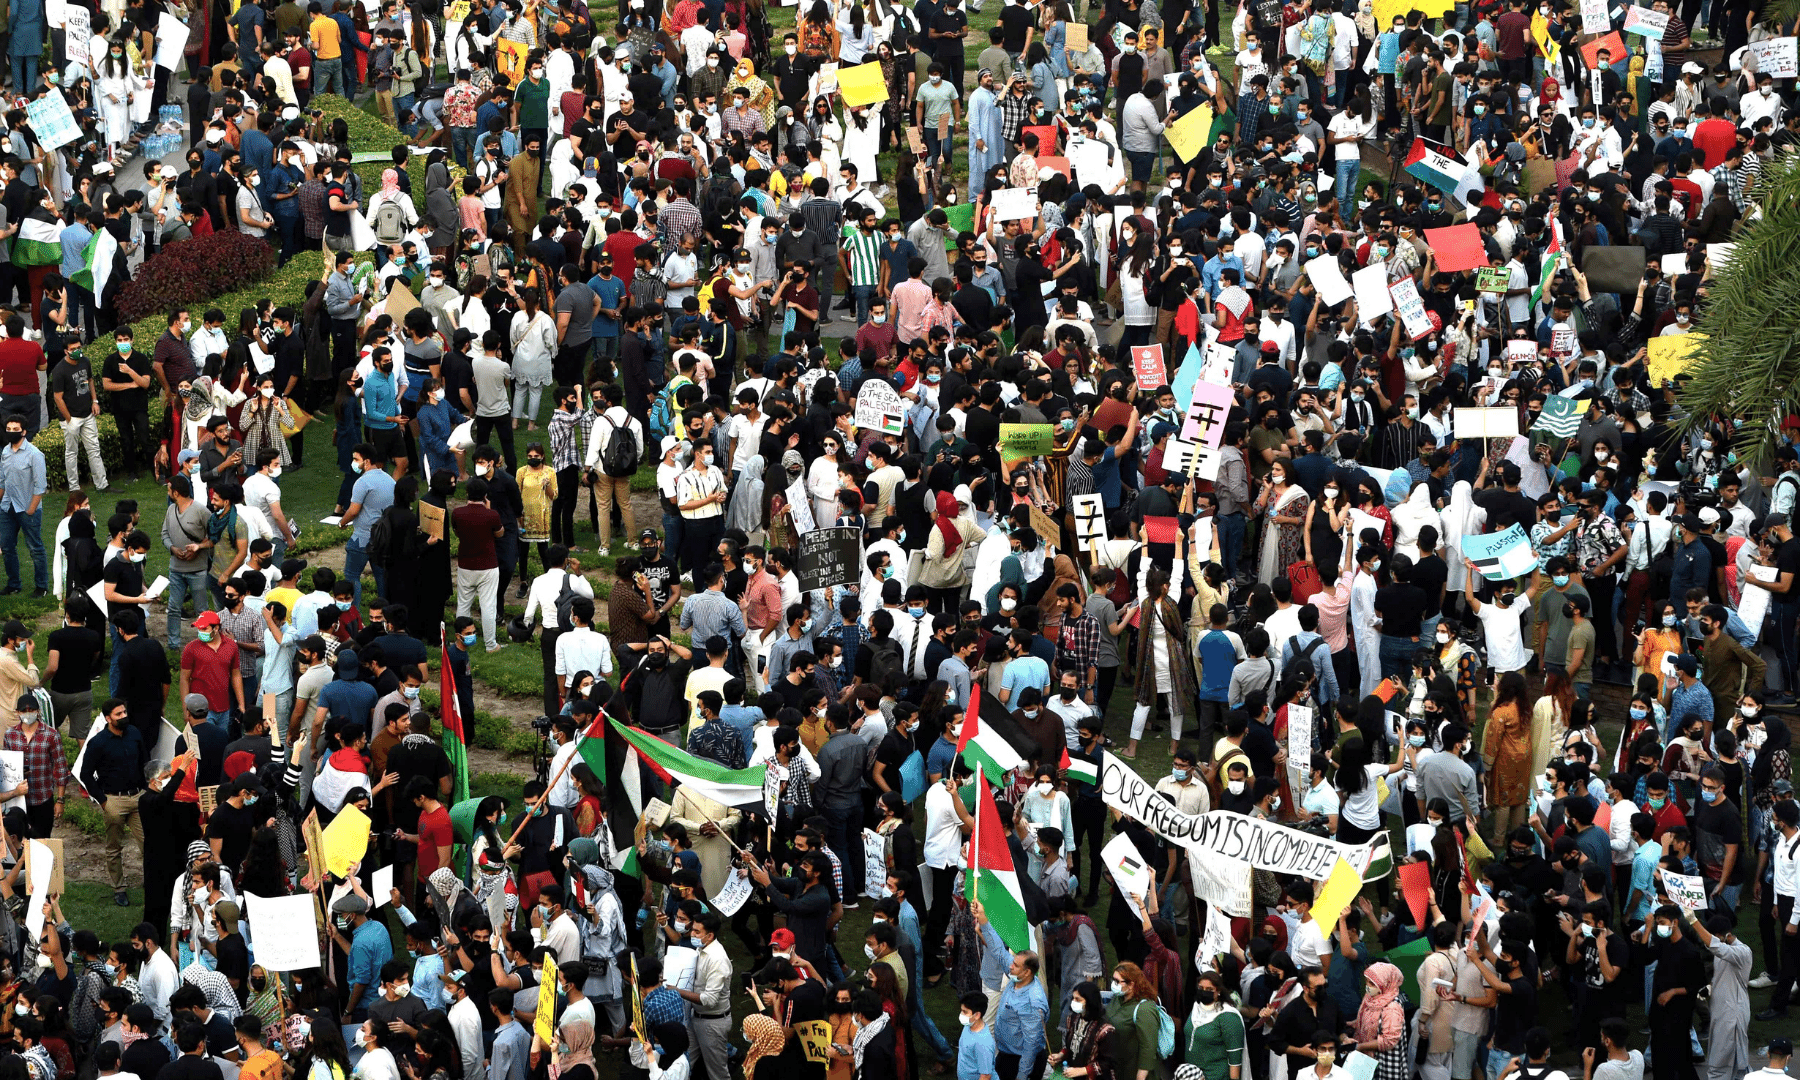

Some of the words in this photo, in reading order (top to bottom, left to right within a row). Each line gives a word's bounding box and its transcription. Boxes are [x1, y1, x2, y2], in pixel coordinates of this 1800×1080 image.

[1436, 145, 1457, 159] END
[1434, 154, 1450, 170] THE
[868, 389, 883, 400] THE
[884, 393, 900, 404] SEA
[859, 399, 902, 414] PALESTINE
[804, 529, 836, 545] PEACE
[842, 528, 856, 540] IN
[799, 541, 829, 559] PALESTINE
[817, 549, 840, 566] NOT
[836, 563, 844, 572] IN
[1102, 763, 1144, 815] OUR
[1142, 793, 1221, 849] FREEDOM
[1216, 815, 1248, 857] IS
[1240, 824, 1337, 877] INCOMPLETE
[721, 885, 748, 914] Palestine
[1677, 889, 1704, 900] UNDER
